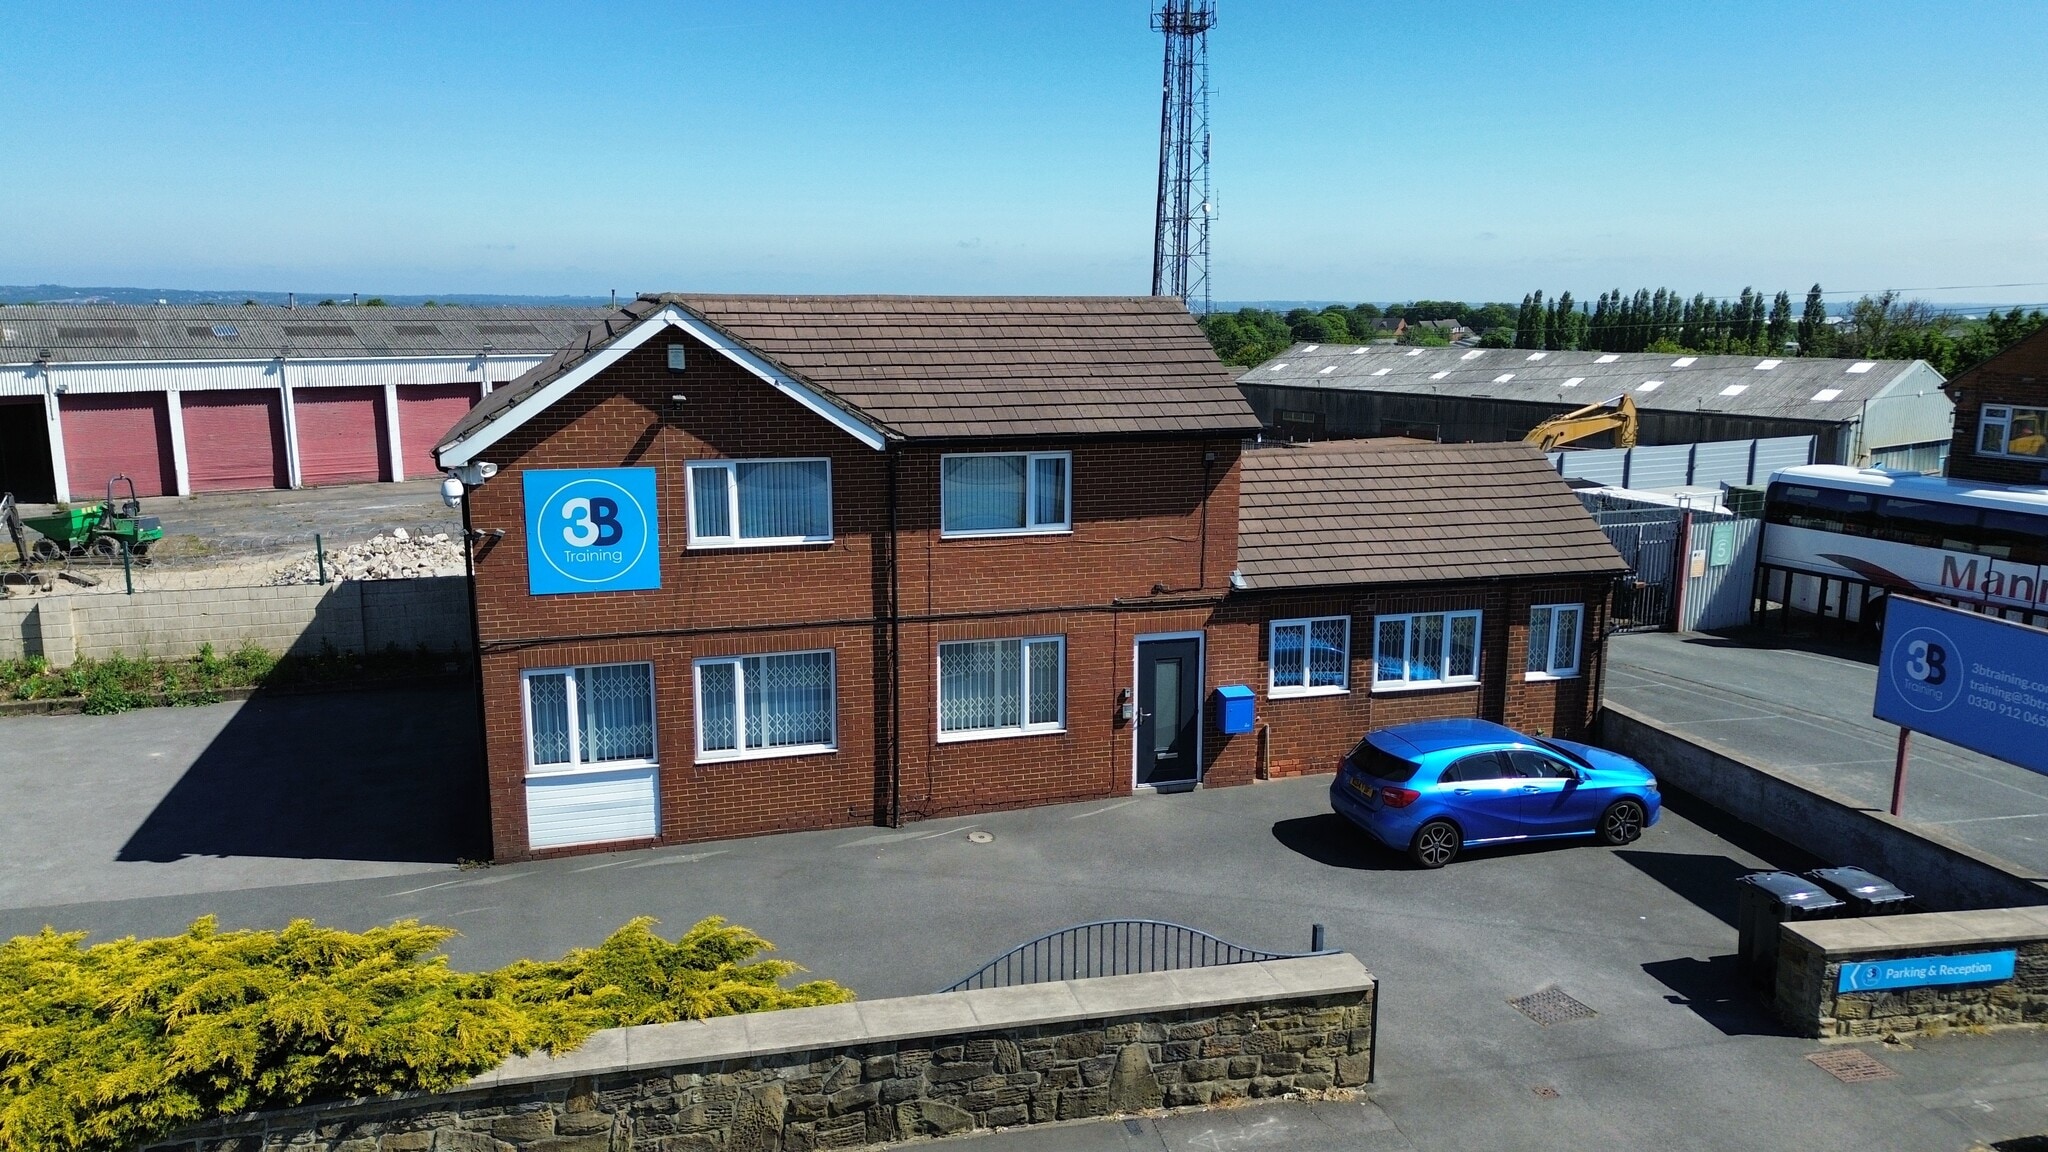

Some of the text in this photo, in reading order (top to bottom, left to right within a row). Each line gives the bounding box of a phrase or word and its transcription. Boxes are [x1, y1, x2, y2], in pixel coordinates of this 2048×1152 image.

[562, 497, 623, 547] 3B
[564, 549, 622, 563] Training
[1717, 542, 1727, 558] 5
[1906, 640, 1947, 686] 3B
[1905, 678, 1943, 702] Training
[1971, 662, 2048, 694] 3btraining.co
[1967, 694, 2048, 728] 0330 912 065
[1886, 962, 1992, 979] Parking & Reception
